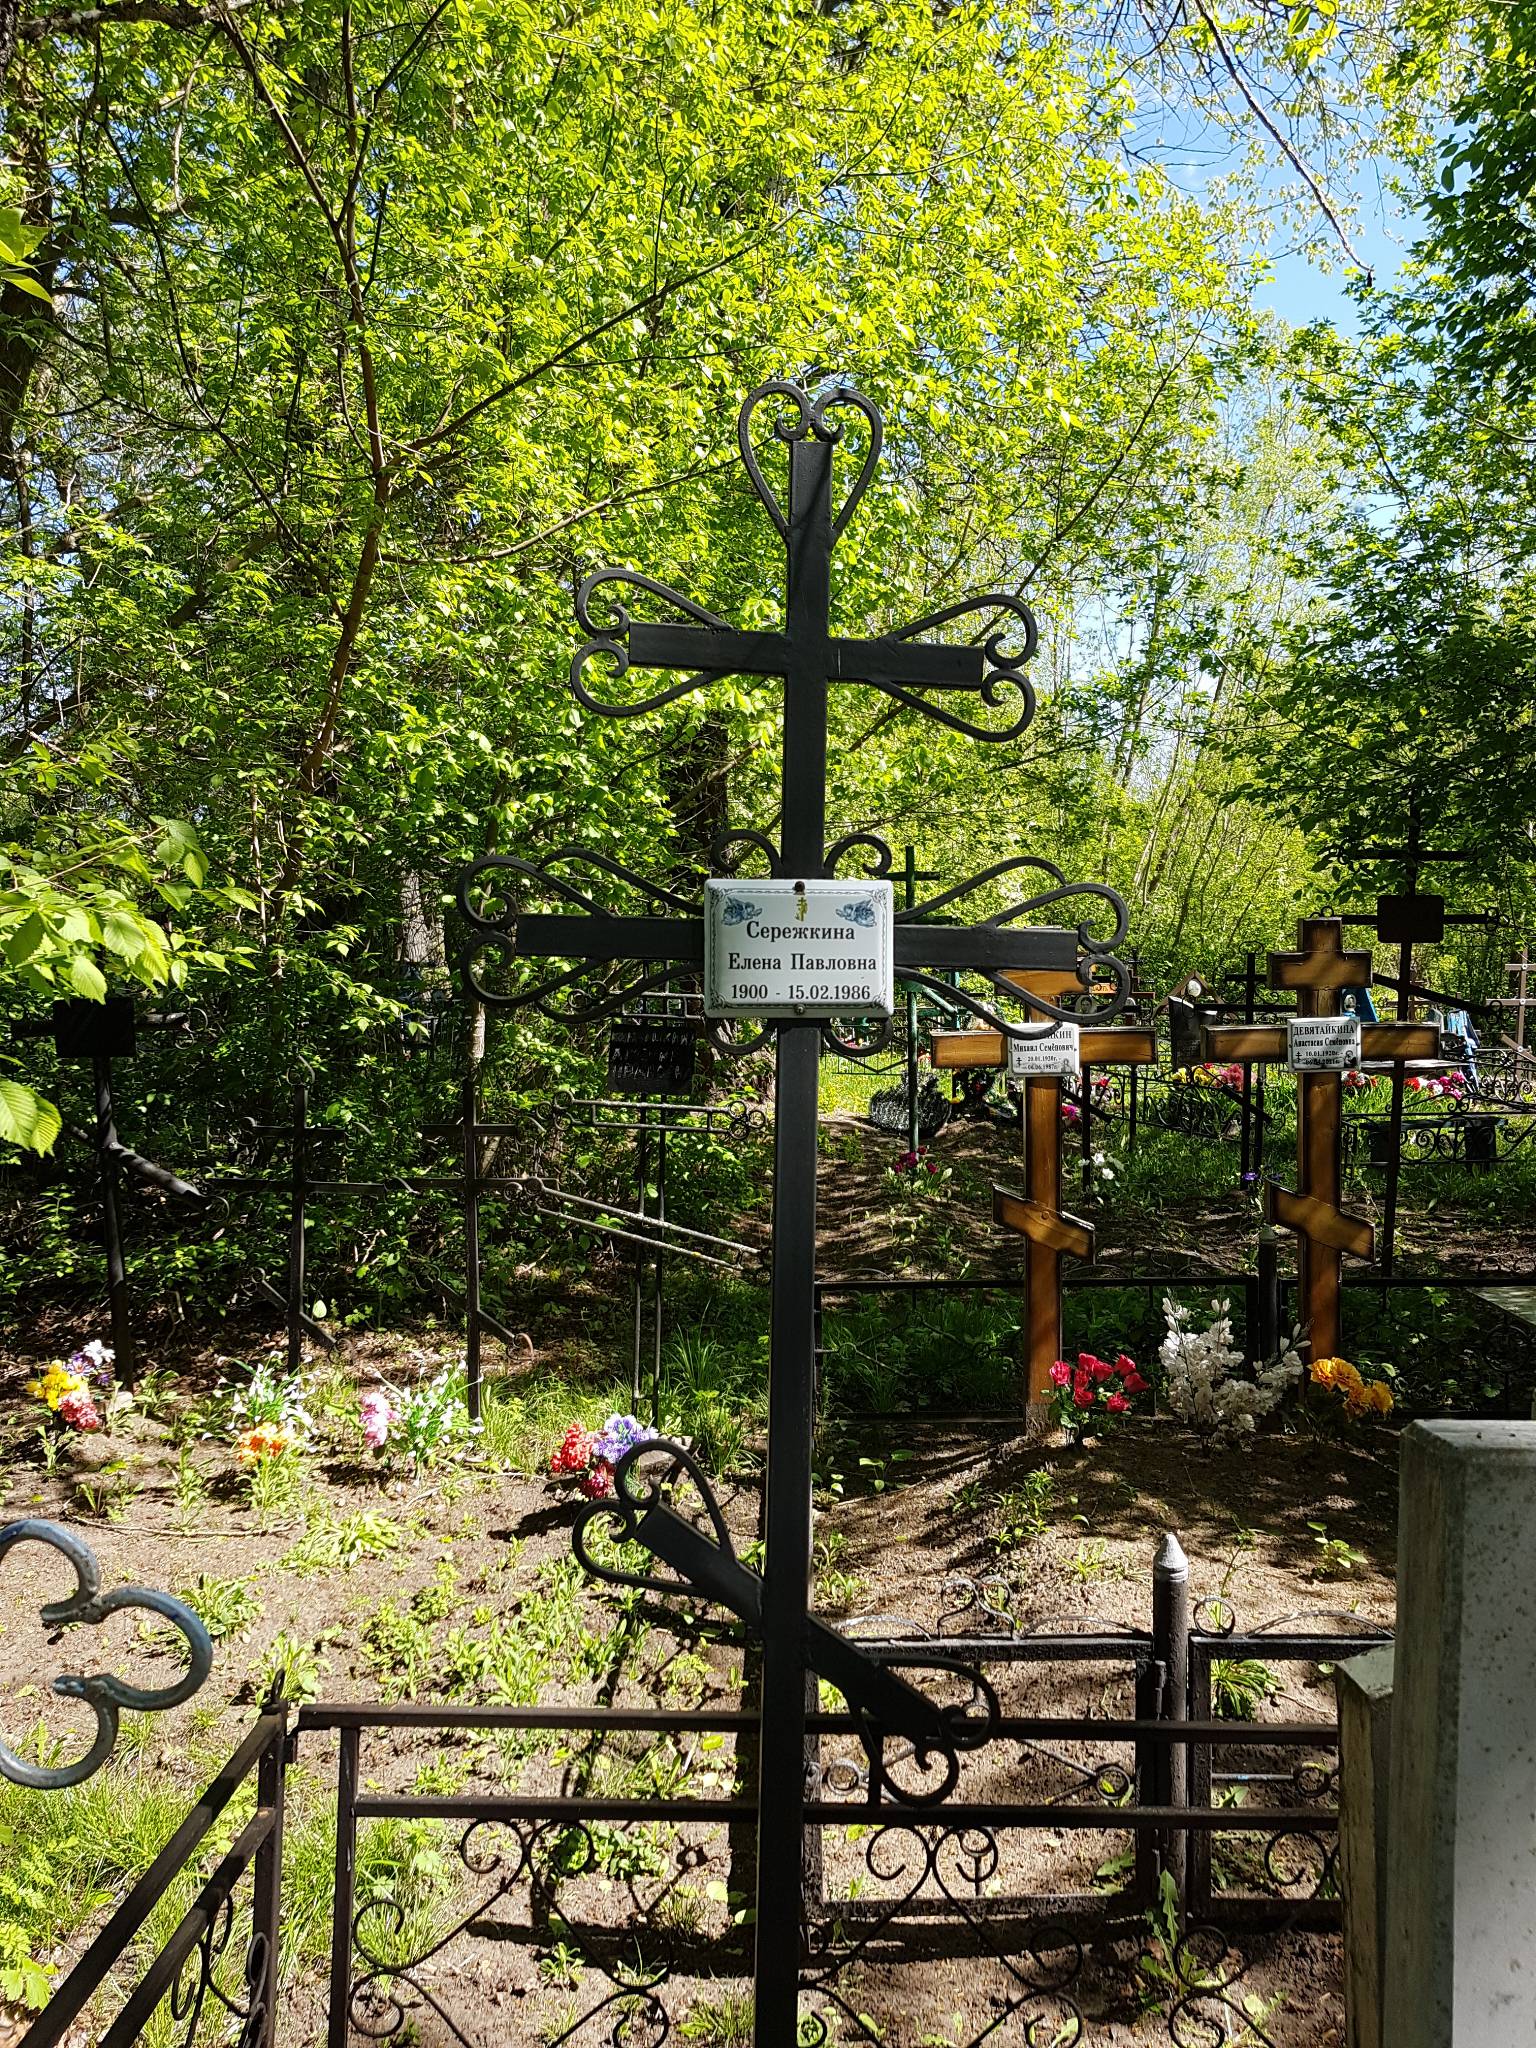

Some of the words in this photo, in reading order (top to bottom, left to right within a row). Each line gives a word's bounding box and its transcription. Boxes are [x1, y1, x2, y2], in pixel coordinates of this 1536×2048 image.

[746, 920, 855, 942] Сережкина
[728, 953, 781, 970] Елена
[790, 953, 876, 970] Павловна
[731, 984, 768, 999] 1900
[788, 985, 871, 1000] 15.02.1986
[1293, 1024, 1355, 1036] ДЕВЯТАЙКИНА
[1013, 1043, 1038, 1052] Михаил
[1039, 1043, 1074, 1052] Семёнович
